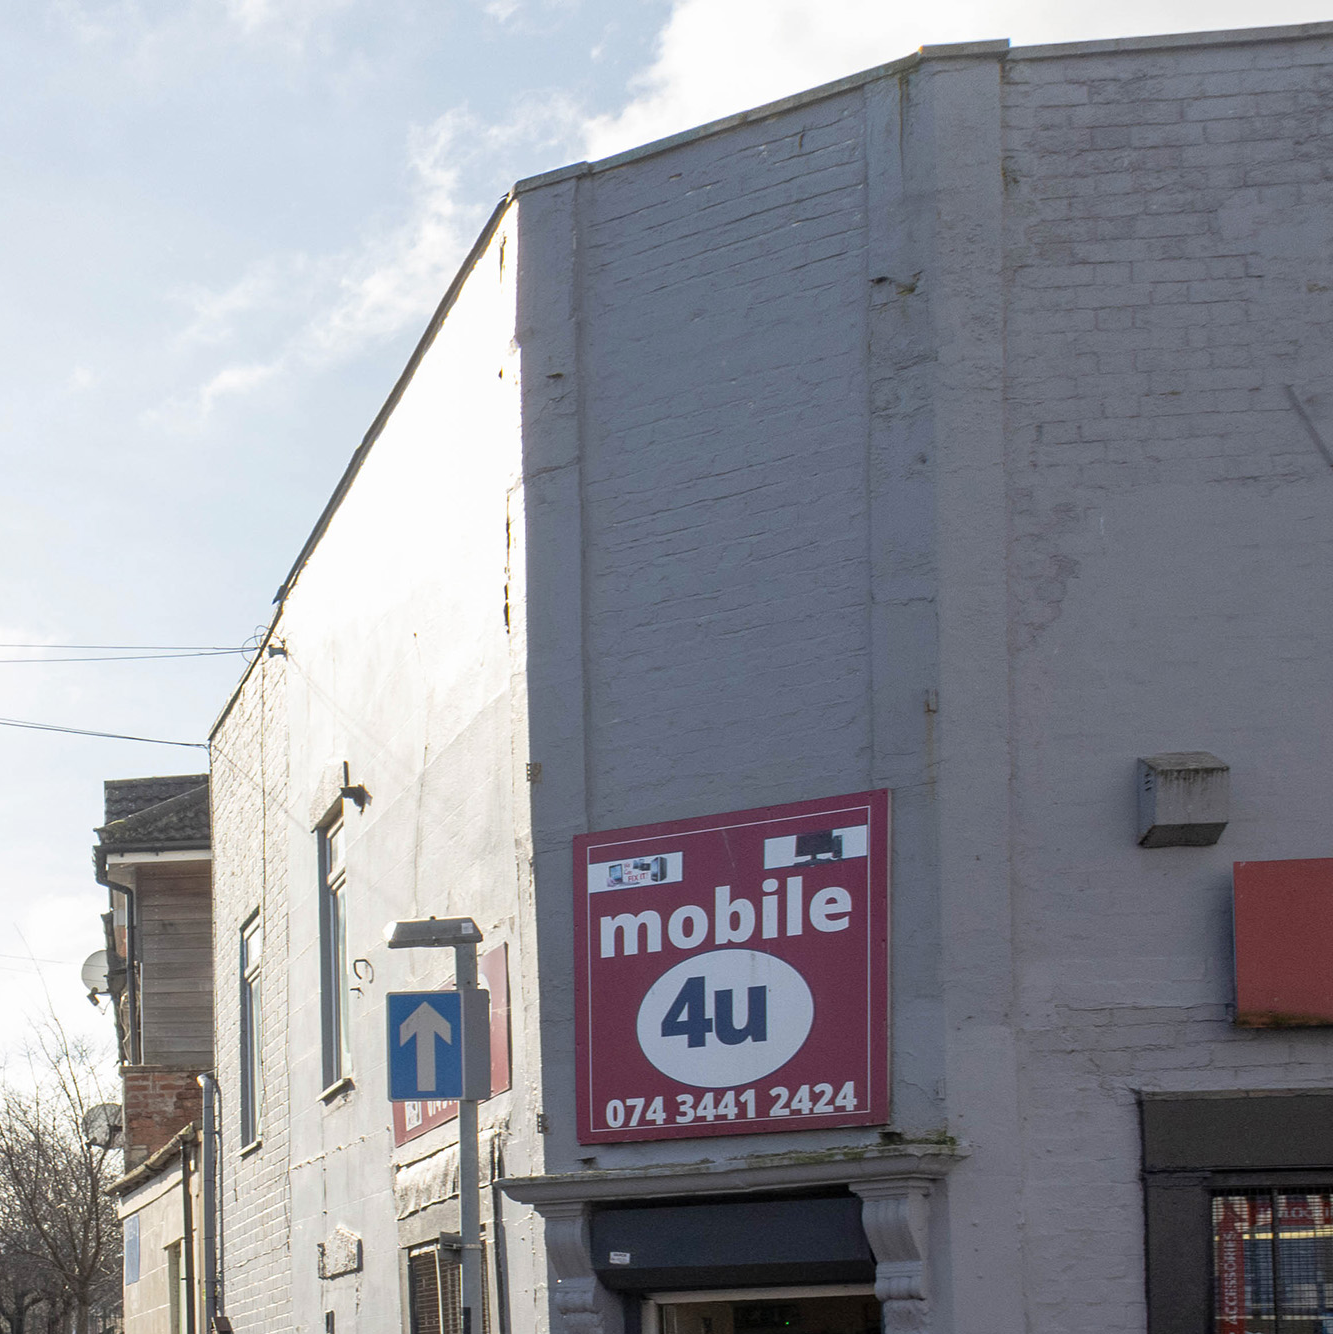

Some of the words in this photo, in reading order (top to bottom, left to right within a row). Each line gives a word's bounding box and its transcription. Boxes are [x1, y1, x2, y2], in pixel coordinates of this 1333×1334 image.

[600, 876, 852, 958] mobile
[660, 976, 767, 1048] 4u
[605, 1096, 666, 1128] 074
[675, 1088, 756, 1124] 3441
[768, 1081, 858, 1117] 2424
